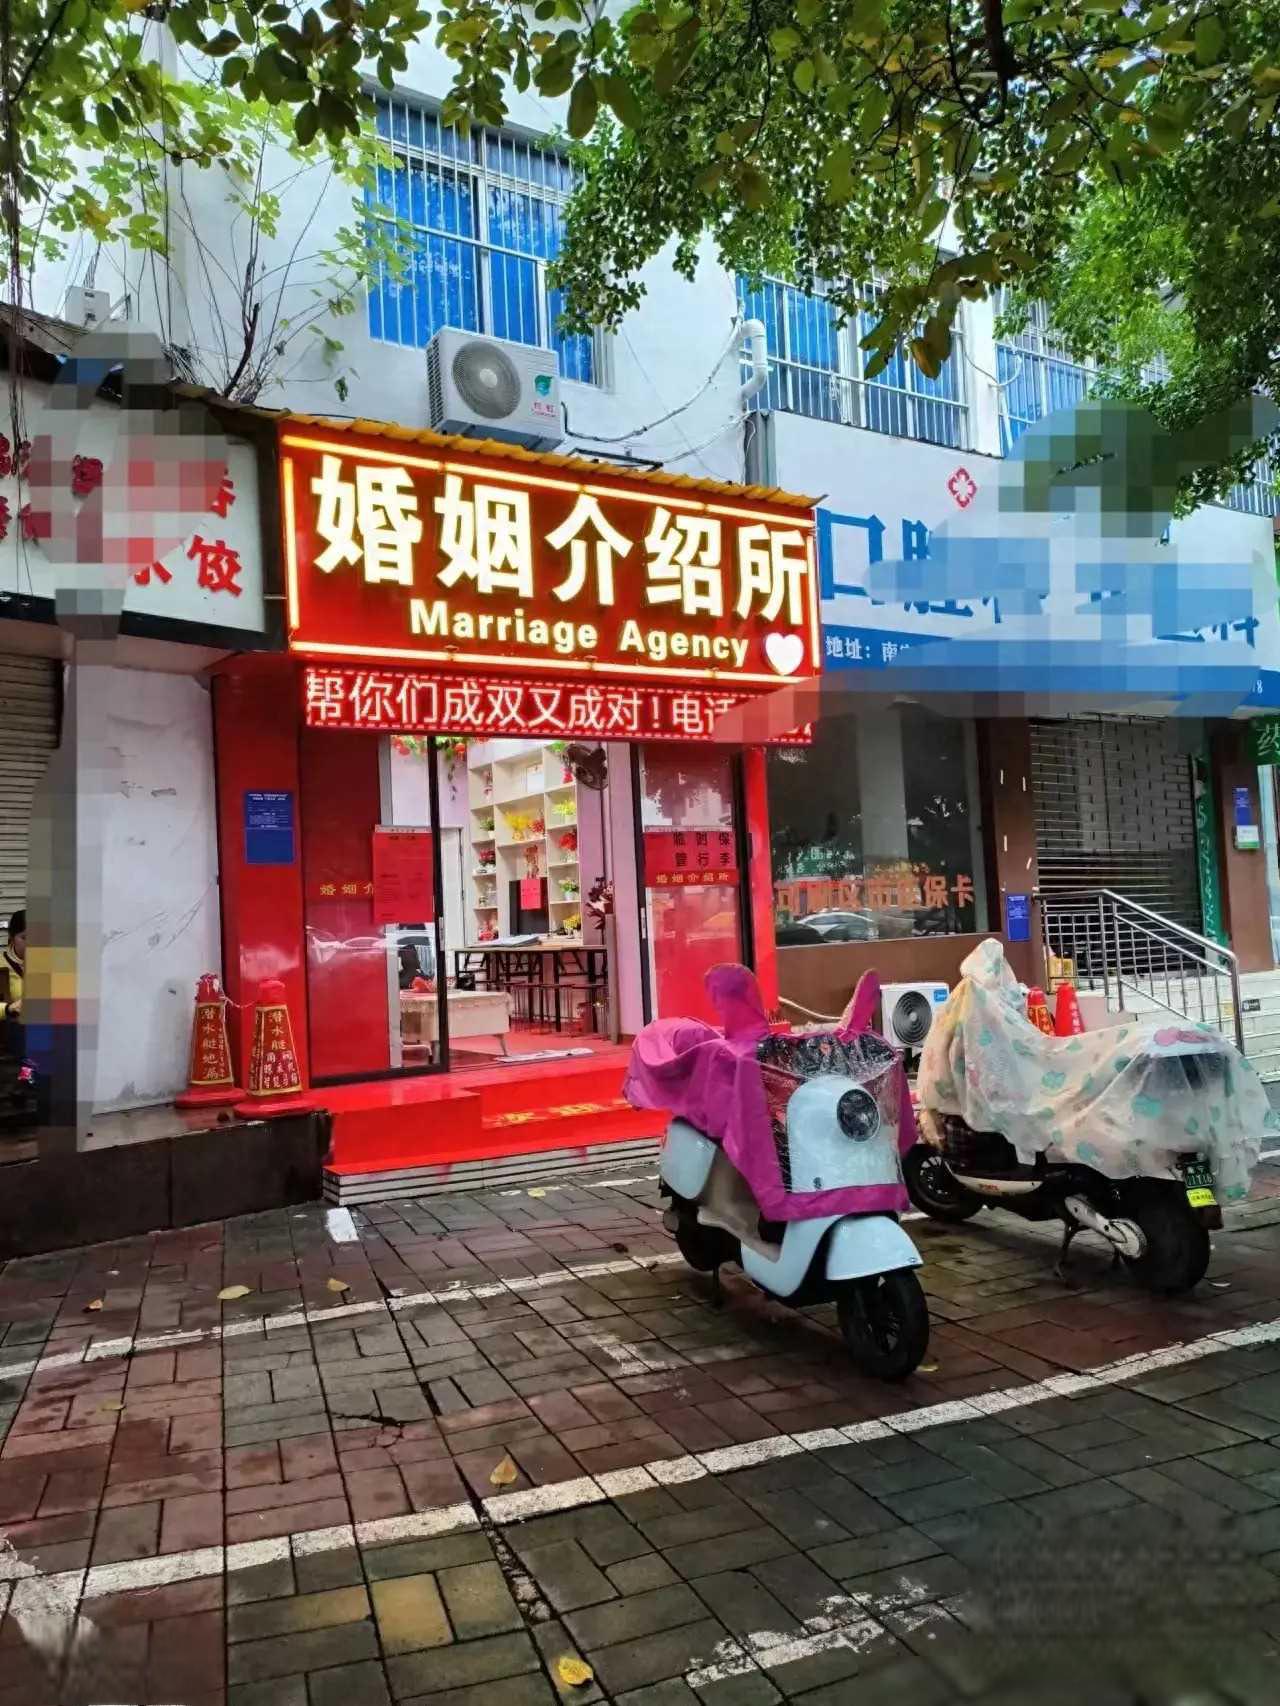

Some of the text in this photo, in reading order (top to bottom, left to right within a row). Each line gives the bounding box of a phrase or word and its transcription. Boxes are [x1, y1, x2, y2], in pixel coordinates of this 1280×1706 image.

[311, 455, 808, 625] 婚姻介绍所
[409, 599, 749, 667] Marriage Agency
